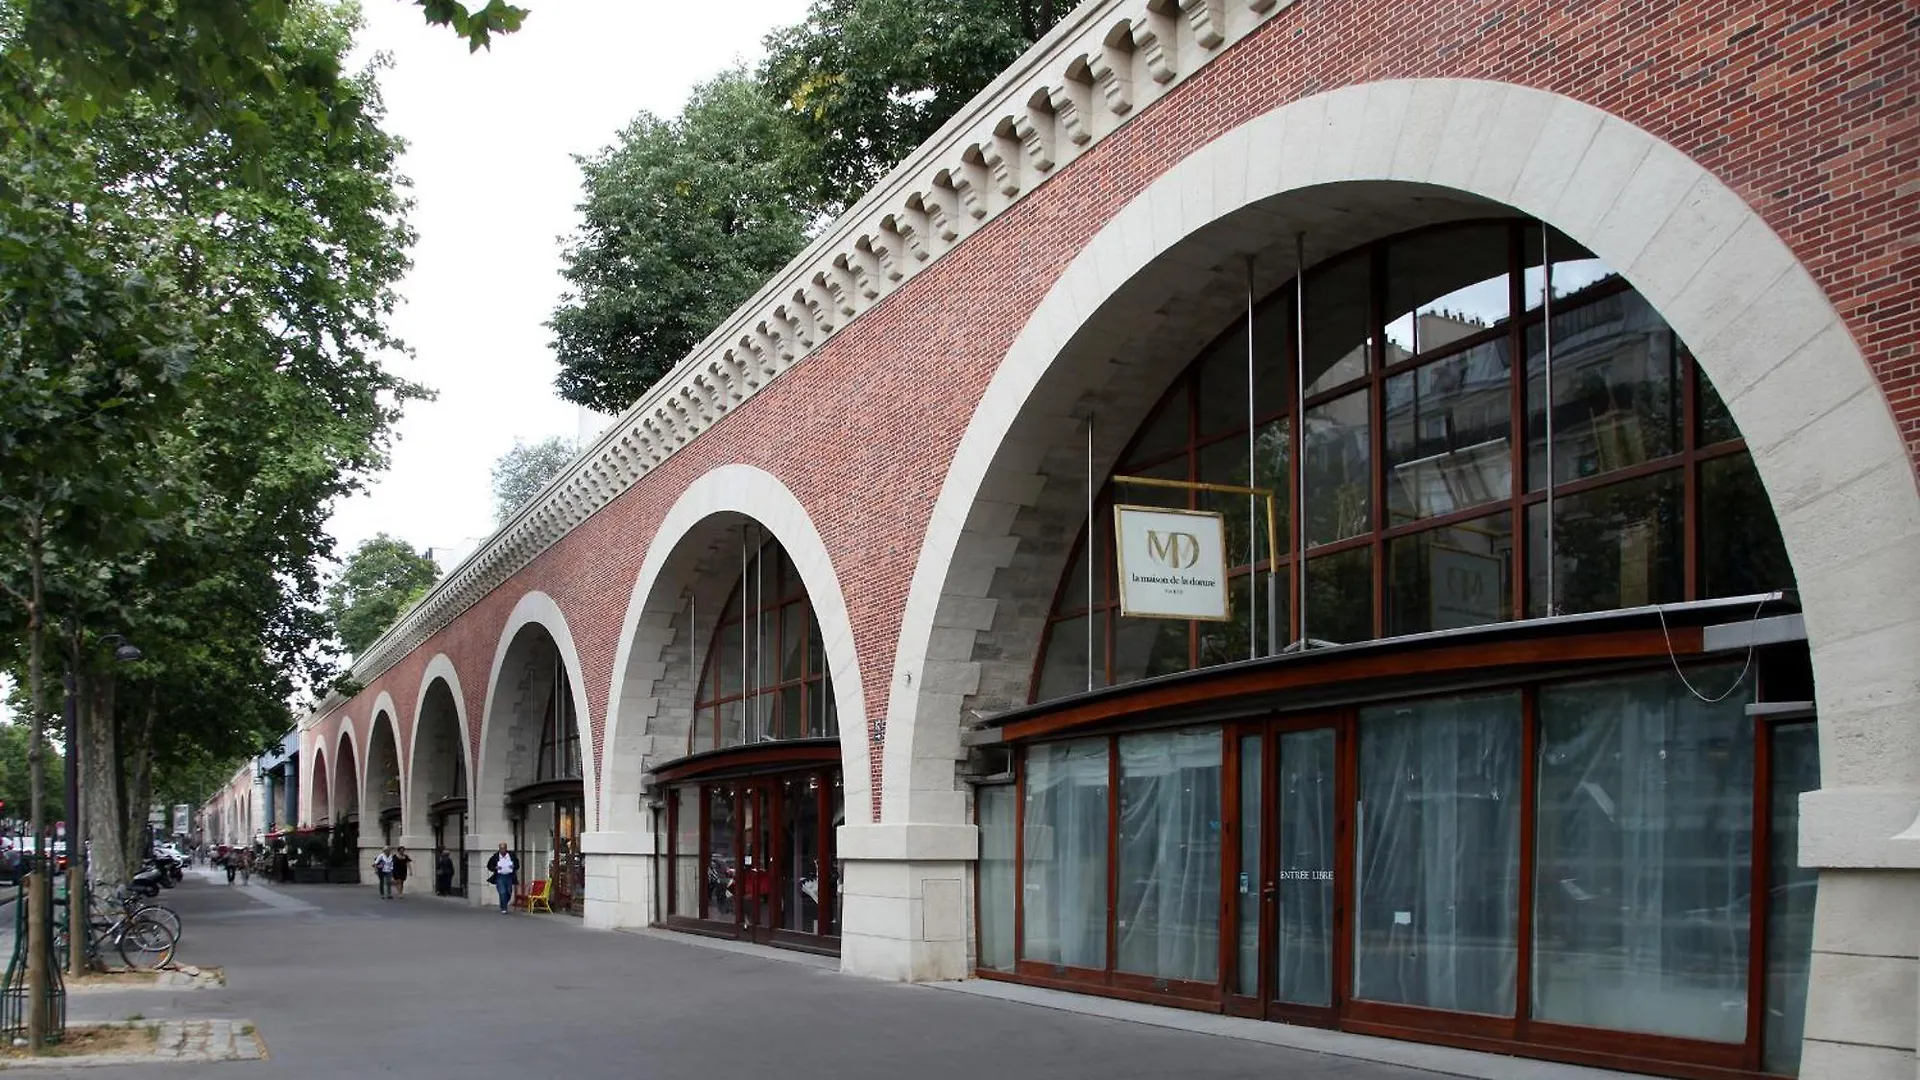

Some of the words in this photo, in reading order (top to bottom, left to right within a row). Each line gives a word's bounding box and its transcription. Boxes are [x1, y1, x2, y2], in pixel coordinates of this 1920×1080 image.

[1147, 529, 1200, 569] MD
[1132, 572, 1140, 582] la
[1141, 574, 1169, 584] maison
[1169, 575, 1180, 585] de
[1181, 576, 1189, 585] la
[1312, 870, 1334, 880] LIBRE
